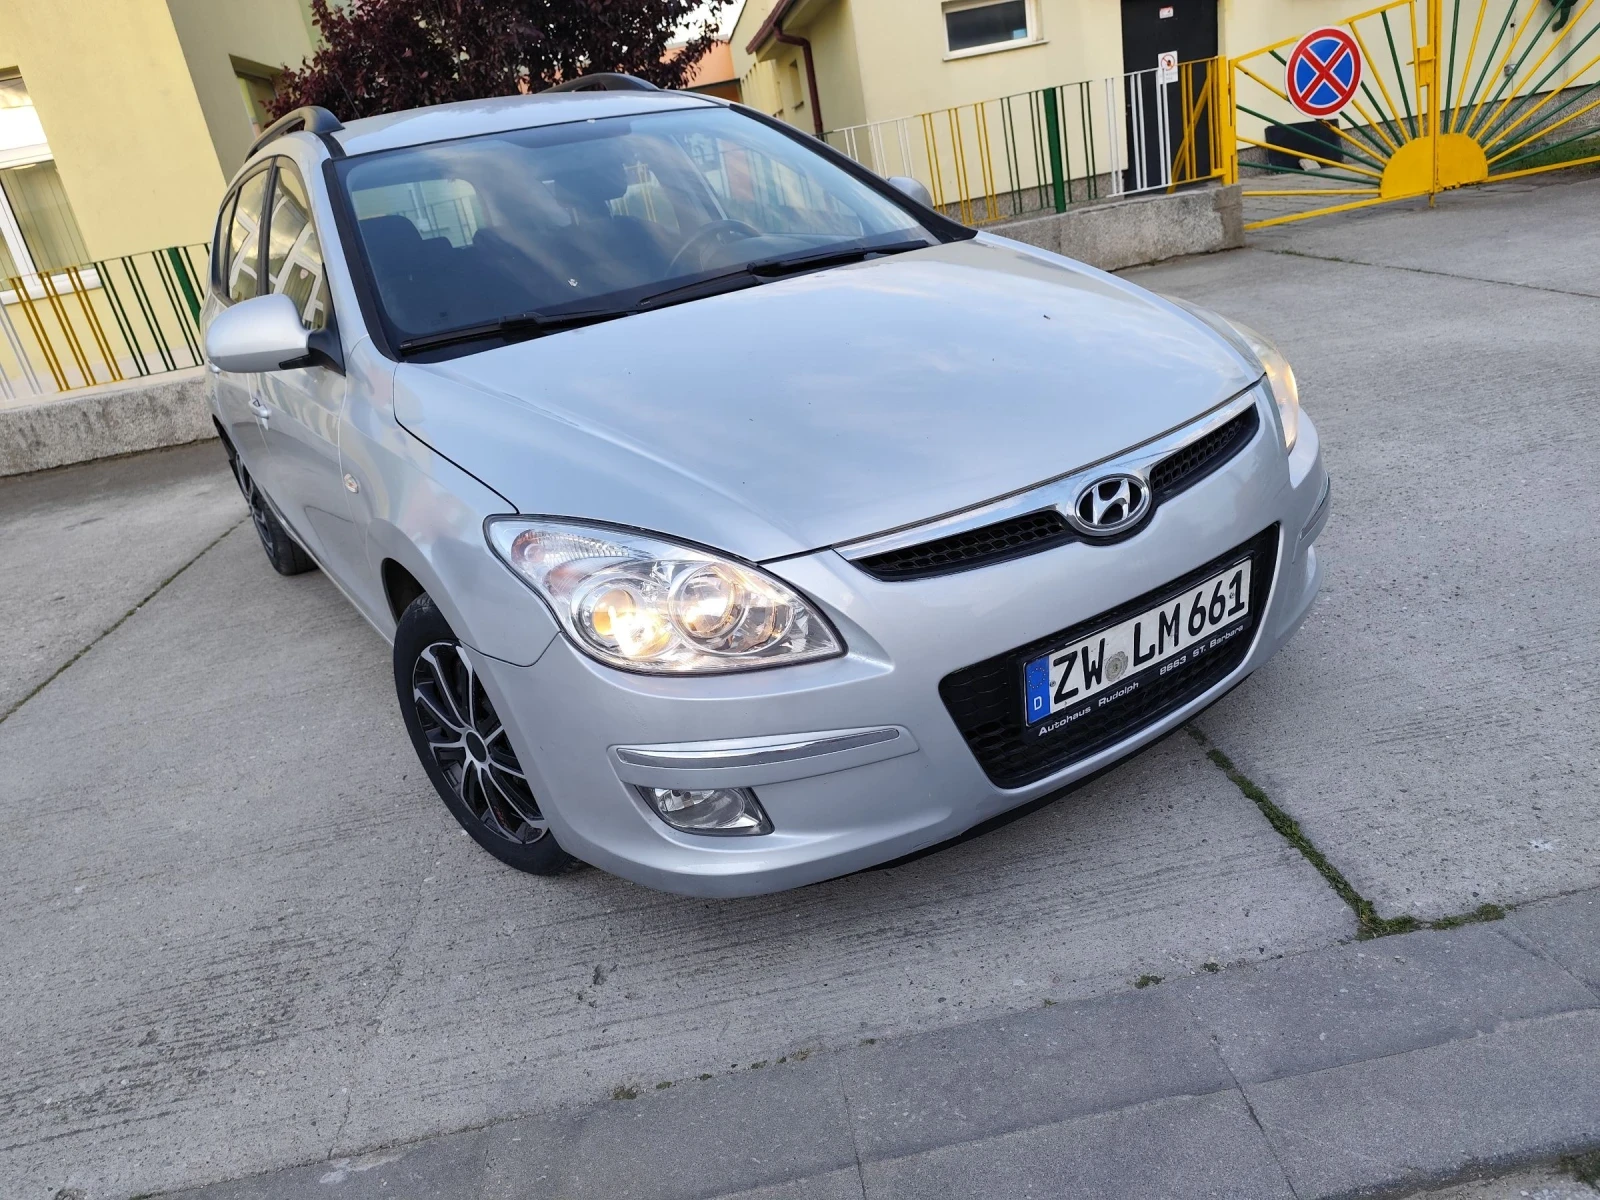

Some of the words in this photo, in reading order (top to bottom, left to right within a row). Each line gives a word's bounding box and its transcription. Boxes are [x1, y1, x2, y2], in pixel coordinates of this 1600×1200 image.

[1034, 696, 1042, 710] D
[1038, 706, 1091, 736] Autohaus
[1098, 682, 1139, 707] Rudolph
[1209, 625, 1244, 648] Barbara
[1053, 638, 1105, 704] ZW
